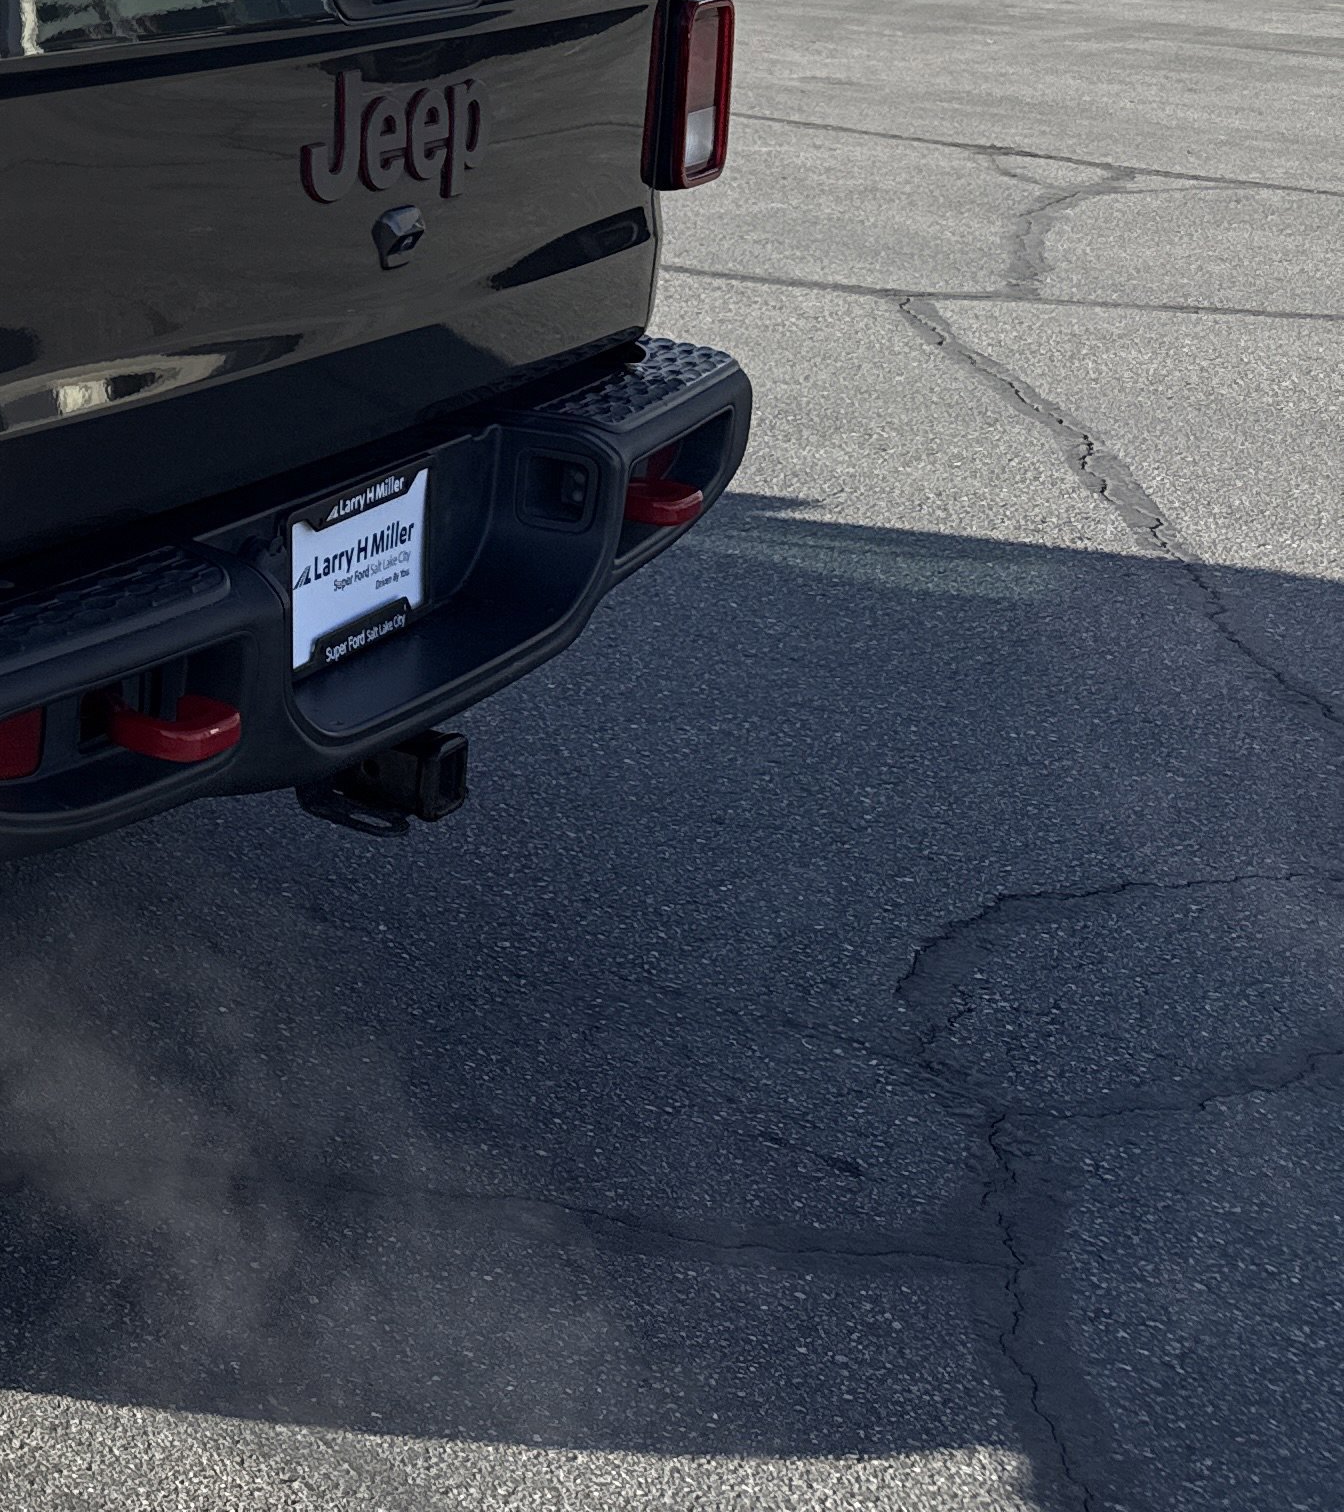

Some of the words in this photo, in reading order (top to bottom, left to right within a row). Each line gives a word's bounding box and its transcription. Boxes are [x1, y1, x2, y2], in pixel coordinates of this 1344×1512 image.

[299, 69, 489, 205] Jeep
[339, 492, 365, 516] Larry
[366, 488, 375, 504] H
[375, 475, 405, 500] Miller
[314, 546, 355, 581] Larry
[356, 535, 369, 564] H
[370, 520, 415, 558] Miller
[333, 574, 354, 592] Super
[354, 563, 370, 583] Ford
[325, 640, 348, 663] Super
[348, 628, 365, 652] Ford
[366, 625, 379, 643] Salt
[378, 620, 394, 636] Lake
[393, 613, 406, 628] City
